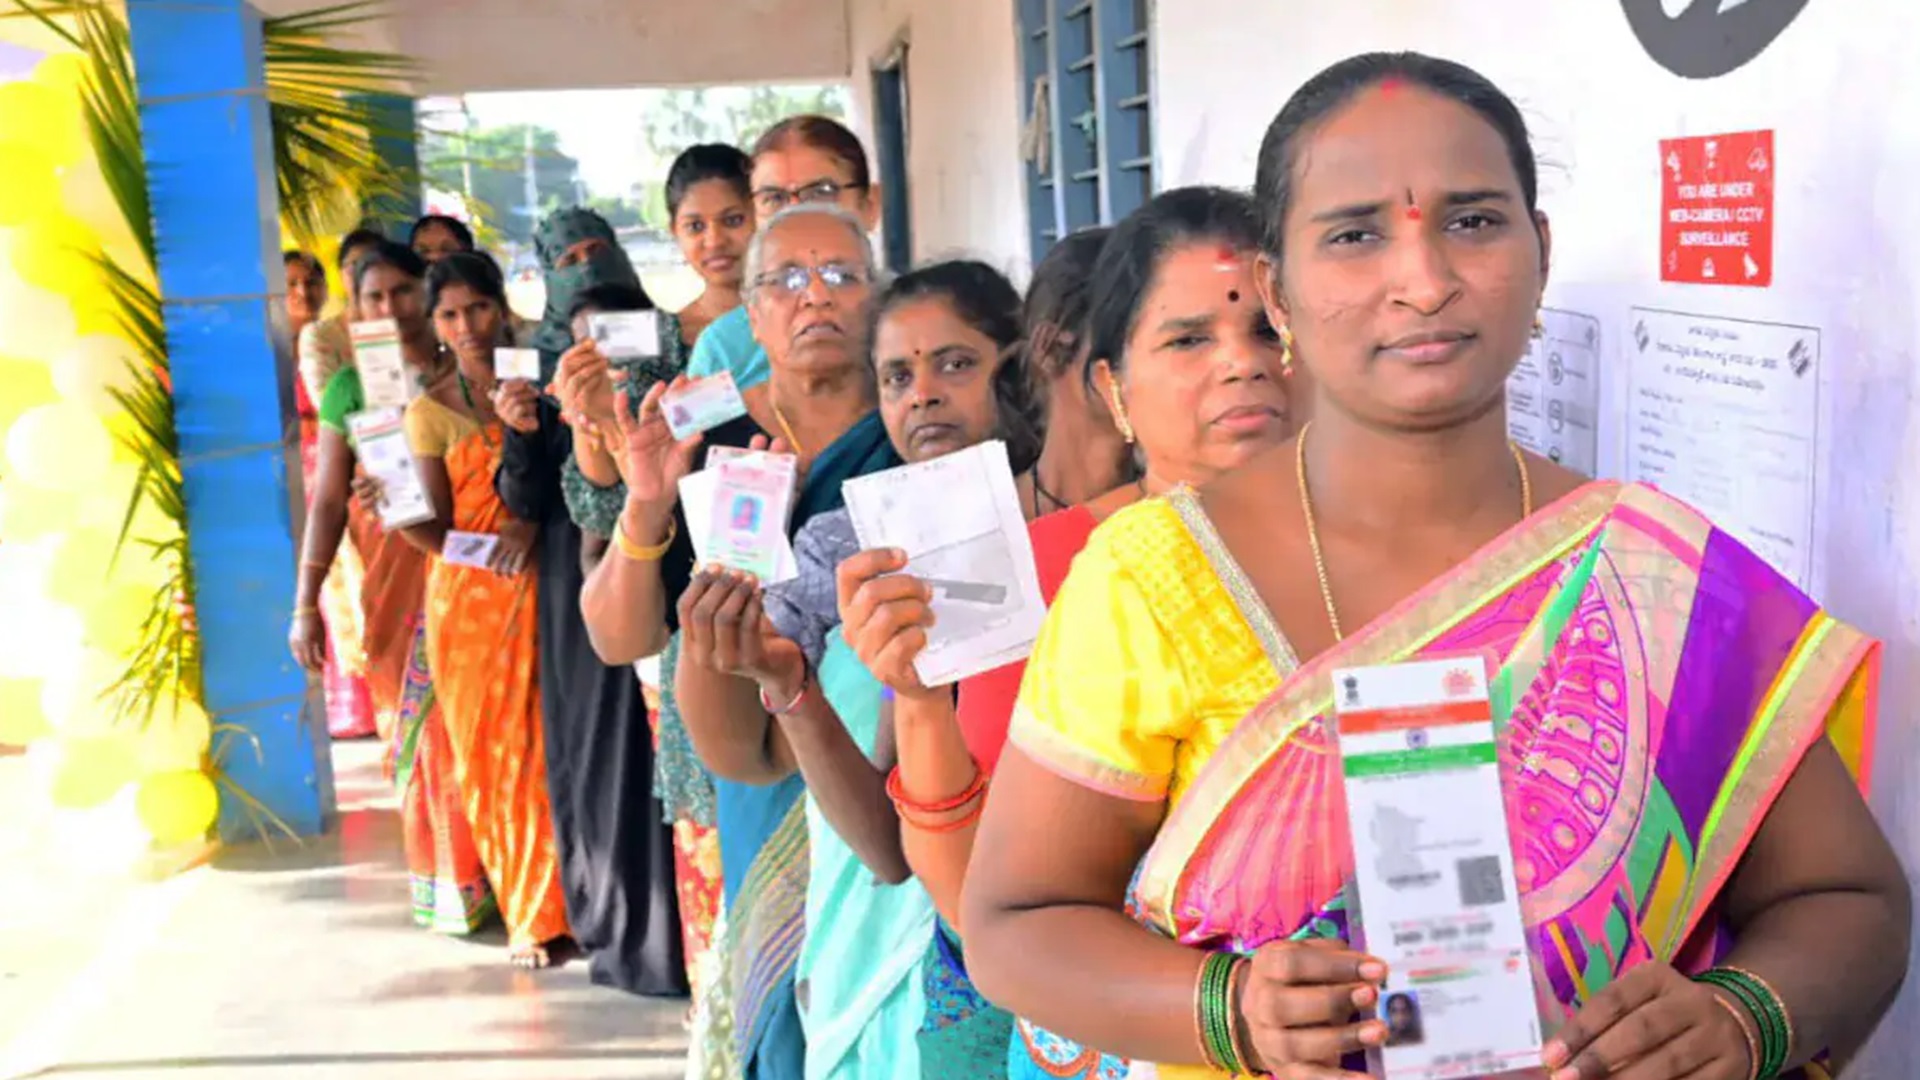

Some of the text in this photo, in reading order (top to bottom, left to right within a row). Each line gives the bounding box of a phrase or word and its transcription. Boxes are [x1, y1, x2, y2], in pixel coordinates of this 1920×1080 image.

[1678, 181, 1754, 199] YOU ARE UNDER
[1736, 206, 1763, 222] CCTV
